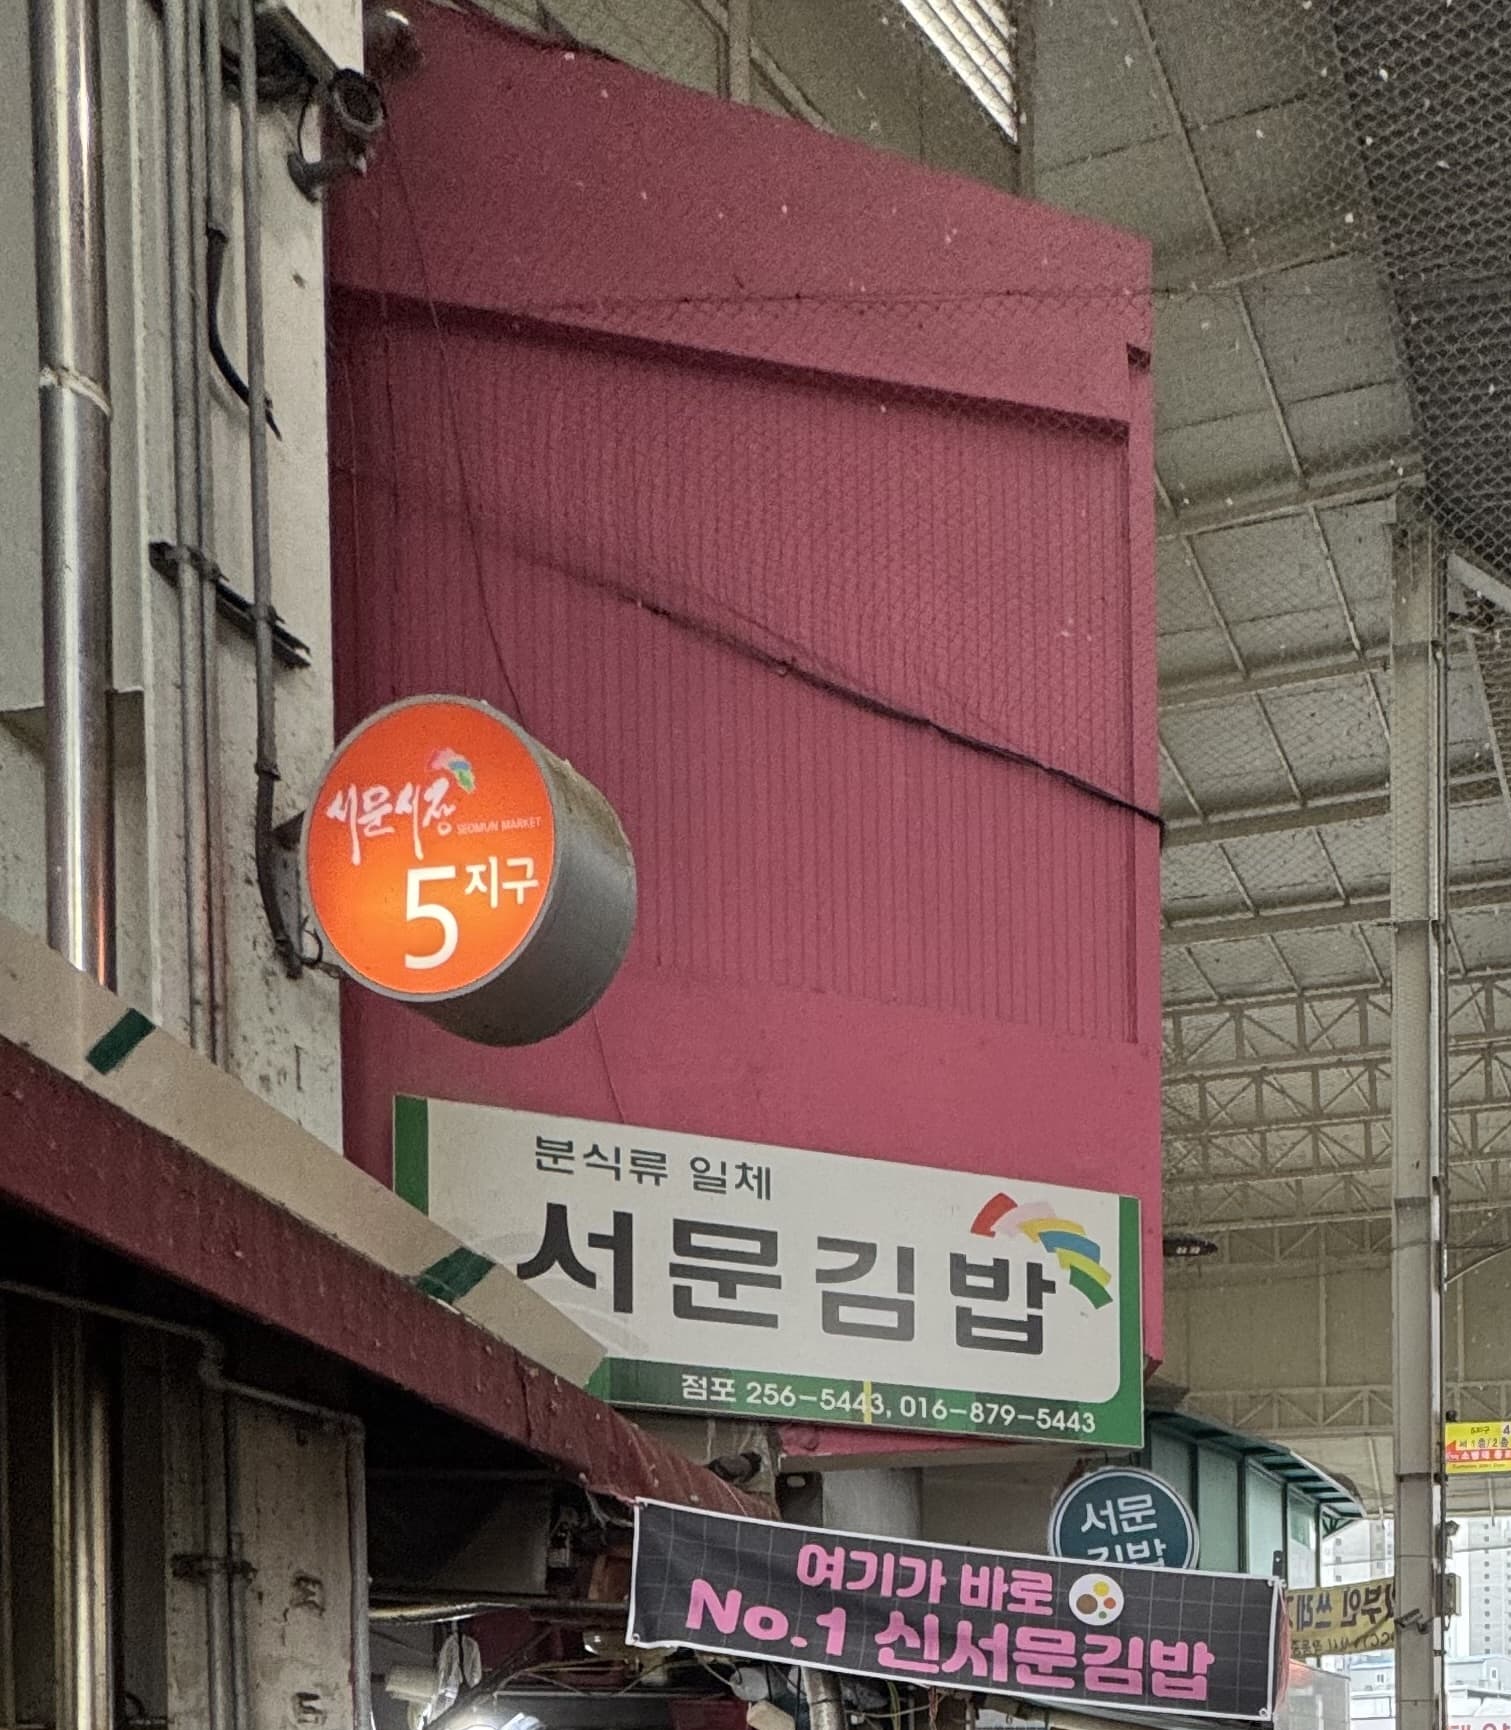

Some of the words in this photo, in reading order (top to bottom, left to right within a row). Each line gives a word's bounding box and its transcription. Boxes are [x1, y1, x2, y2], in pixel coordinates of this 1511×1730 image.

[326, 777, 456, 866] 서문시장
[457, 818, 498, 835] SEOMUN
[501, 816, 542, 832] MARKET
[404, 865, 459, 970] 5
[465, 855, 539, 909] 지구
[536, 1135, 668, 1186] 분식류
[690, 1155, 773, 1200] 일체
[516, 1201, 1056, 1356] 서문김밥
[680, 1371, 737, 1404] 점포
[900, 1395, 1096, 1433] 016-879-5443
[1503, 1424, 1510, 1435] 4
[1081, 1494, 1158, 1536] 서문
[797, 1543, 947, 1605] 여기가
[960, 1563, 1054, 1616] 바로
[686, 1578, 847, 1658] No.1
[874, 1610, 1216, 1701] 신서문김밥
